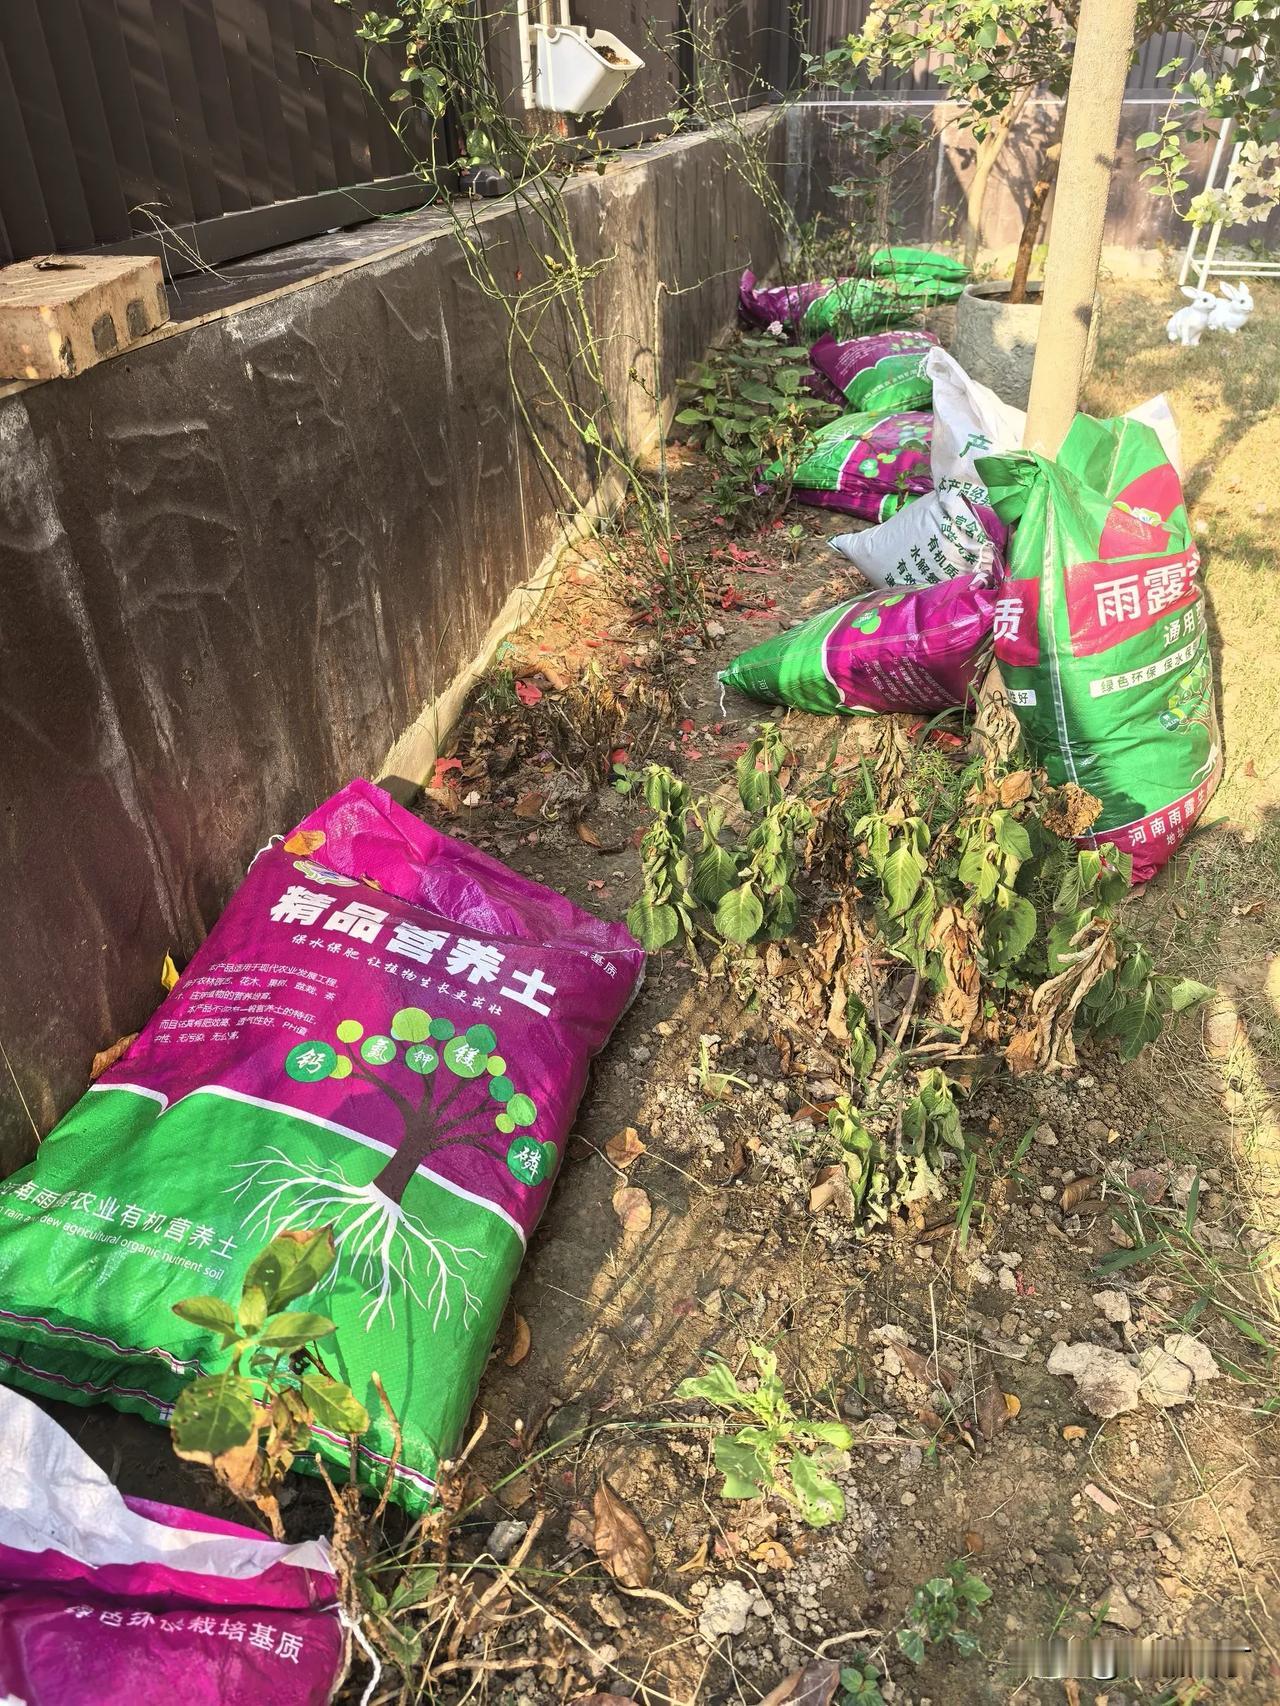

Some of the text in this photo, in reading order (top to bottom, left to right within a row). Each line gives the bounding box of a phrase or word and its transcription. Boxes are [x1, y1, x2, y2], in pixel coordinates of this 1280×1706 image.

[927, 534, 959, 579] 有机质
[1101, 666, 1157, 692] 绿色环保
[270, 885, 556, 1017] 精品营养土
[579, 950, 618, 979] 基质
[291, 933, 502, 1016] 保水保肥 让植物生长更茁壮
[296, 1048, 326, 1074] 钙
[413, 1049, 434, 1069] 钾
[454, 1043, 480, 1074] 镁
[513, 1145, 542, 1182] 磷
[4, 1208, 225, 1280] rain dew agricultural organic nutrient soil
